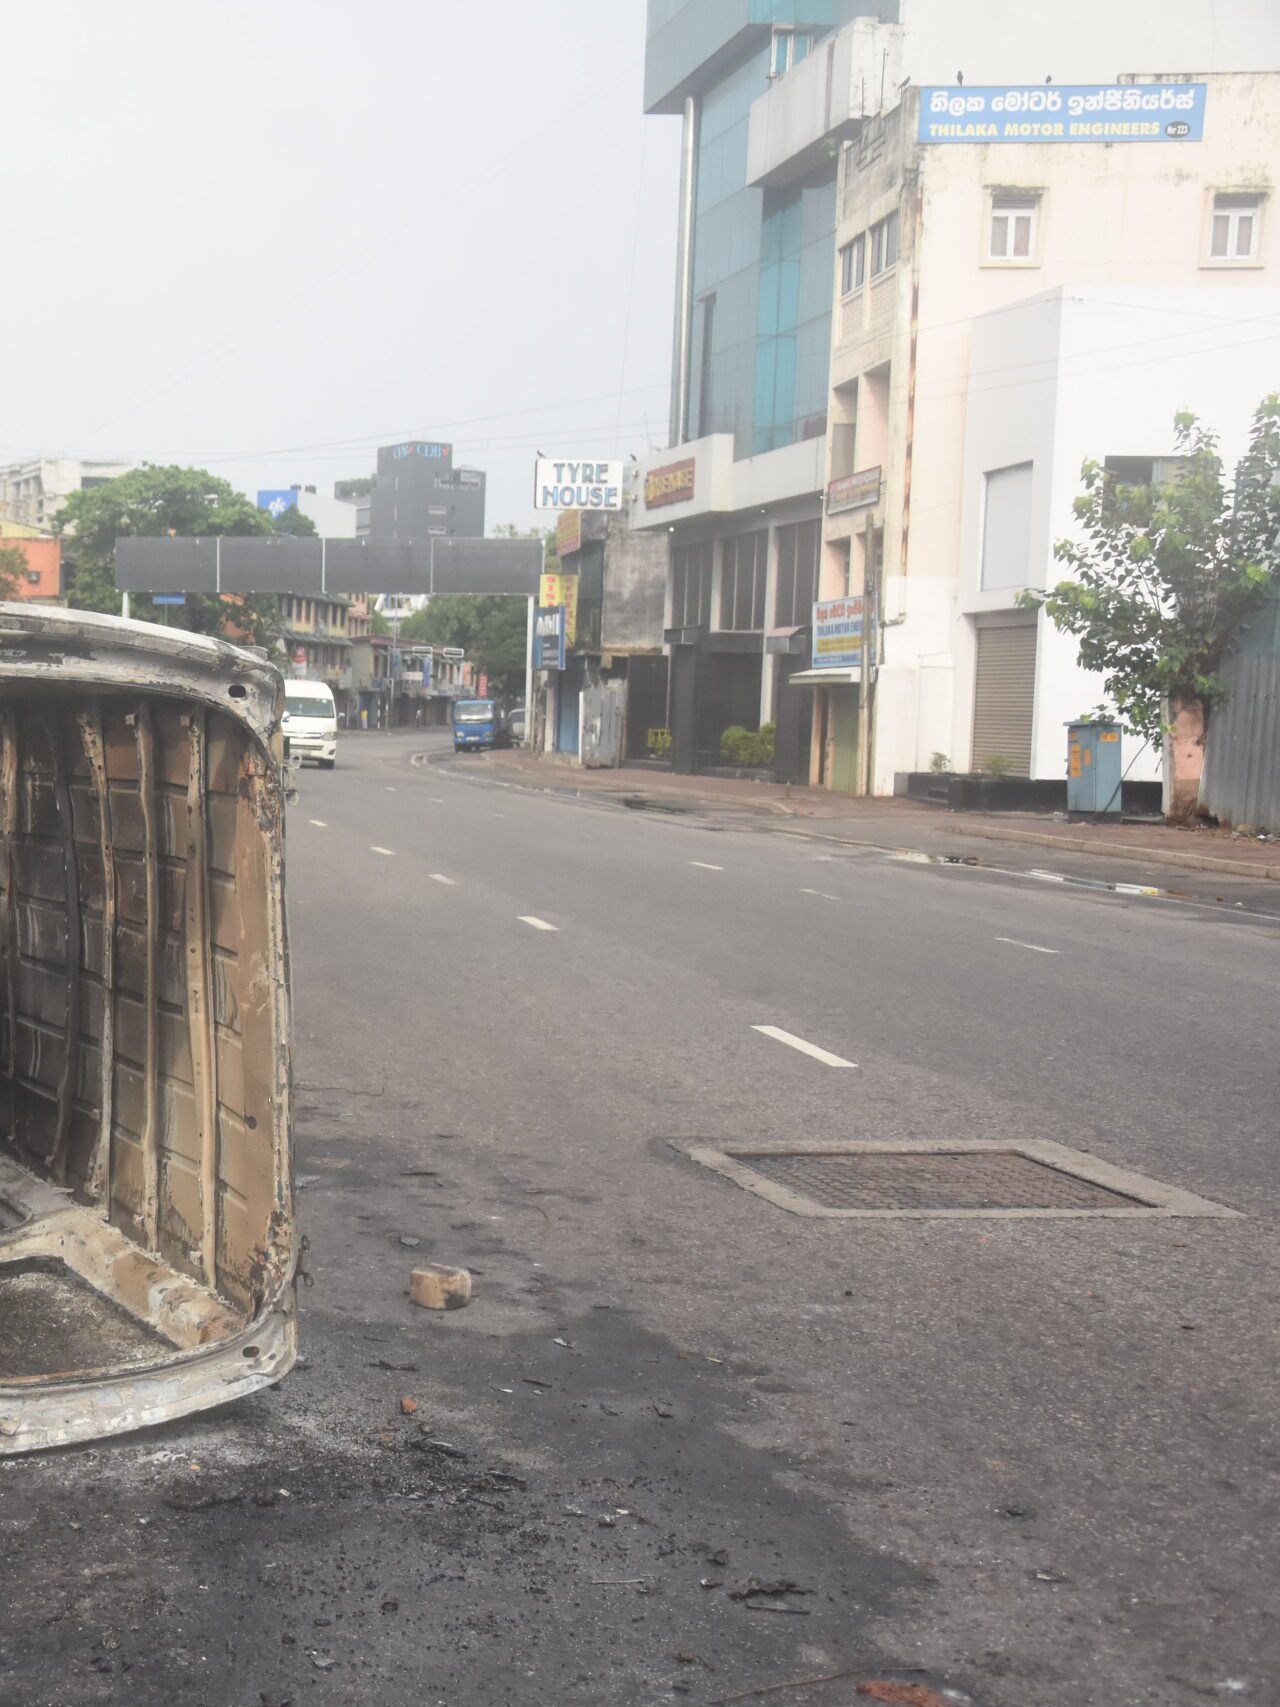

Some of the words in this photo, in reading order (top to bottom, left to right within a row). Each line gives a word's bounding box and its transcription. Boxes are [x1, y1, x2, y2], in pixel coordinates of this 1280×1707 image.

[929, 123, 999, 137] THILAKA
[1004, 123, 1064, 136] MOTOR
[1069, 122, 1160, 136] ENGINEERS
[553, 463, 609, 484] TYRE
[542, 486, 618, 507] HOUSE
